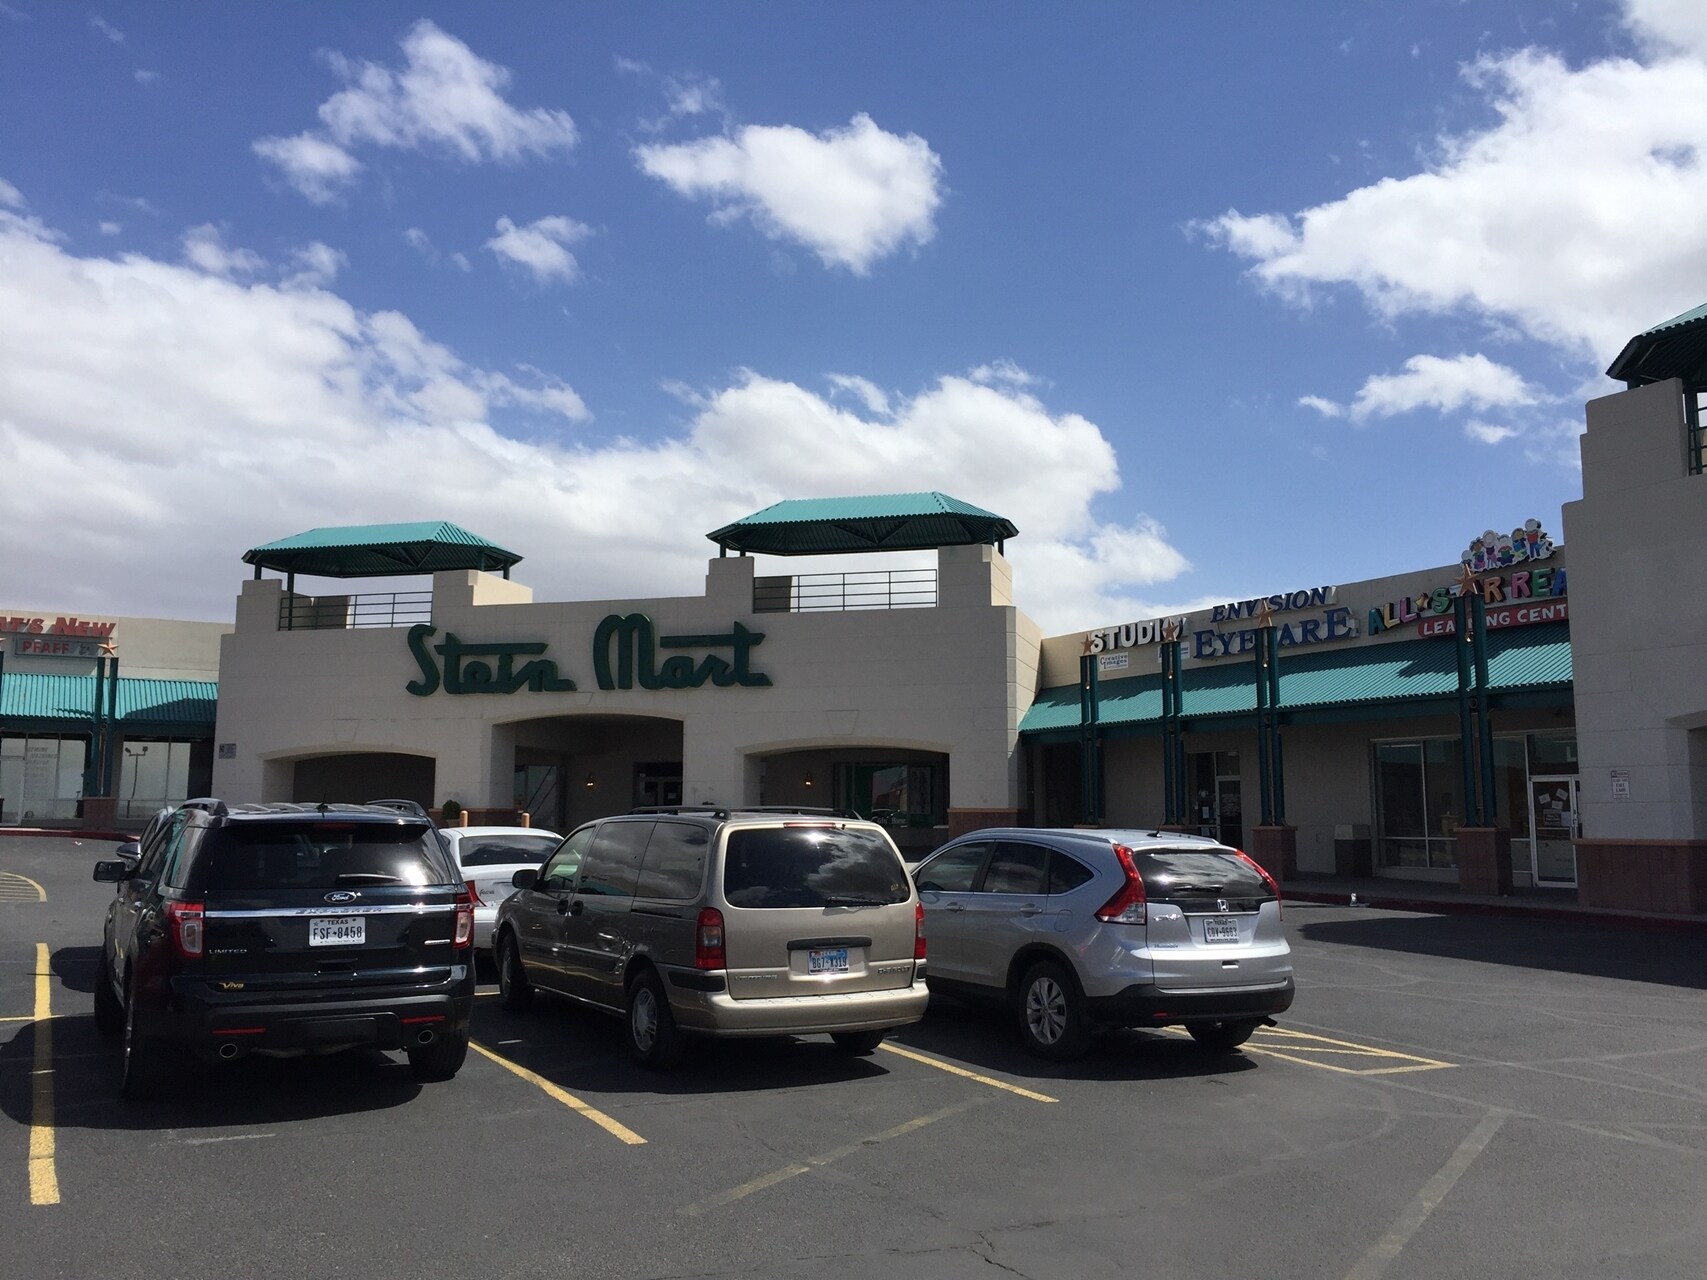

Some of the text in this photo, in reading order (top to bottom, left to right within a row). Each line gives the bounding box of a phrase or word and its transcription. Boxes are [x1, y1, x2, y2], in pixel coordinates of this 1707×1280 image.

[1210, 586, 1330, 623] ENVSION
[1368, 596, 1418, 636] ALL
[1430, 575, 1506, 615] SR
[1423, 612, 1510, 637] LEANG
[22, 640, 70, 655] PFAFF
[405, 613, 773, 696] Stein Mart
[1193, 607, 1352, 659] EYEARE
